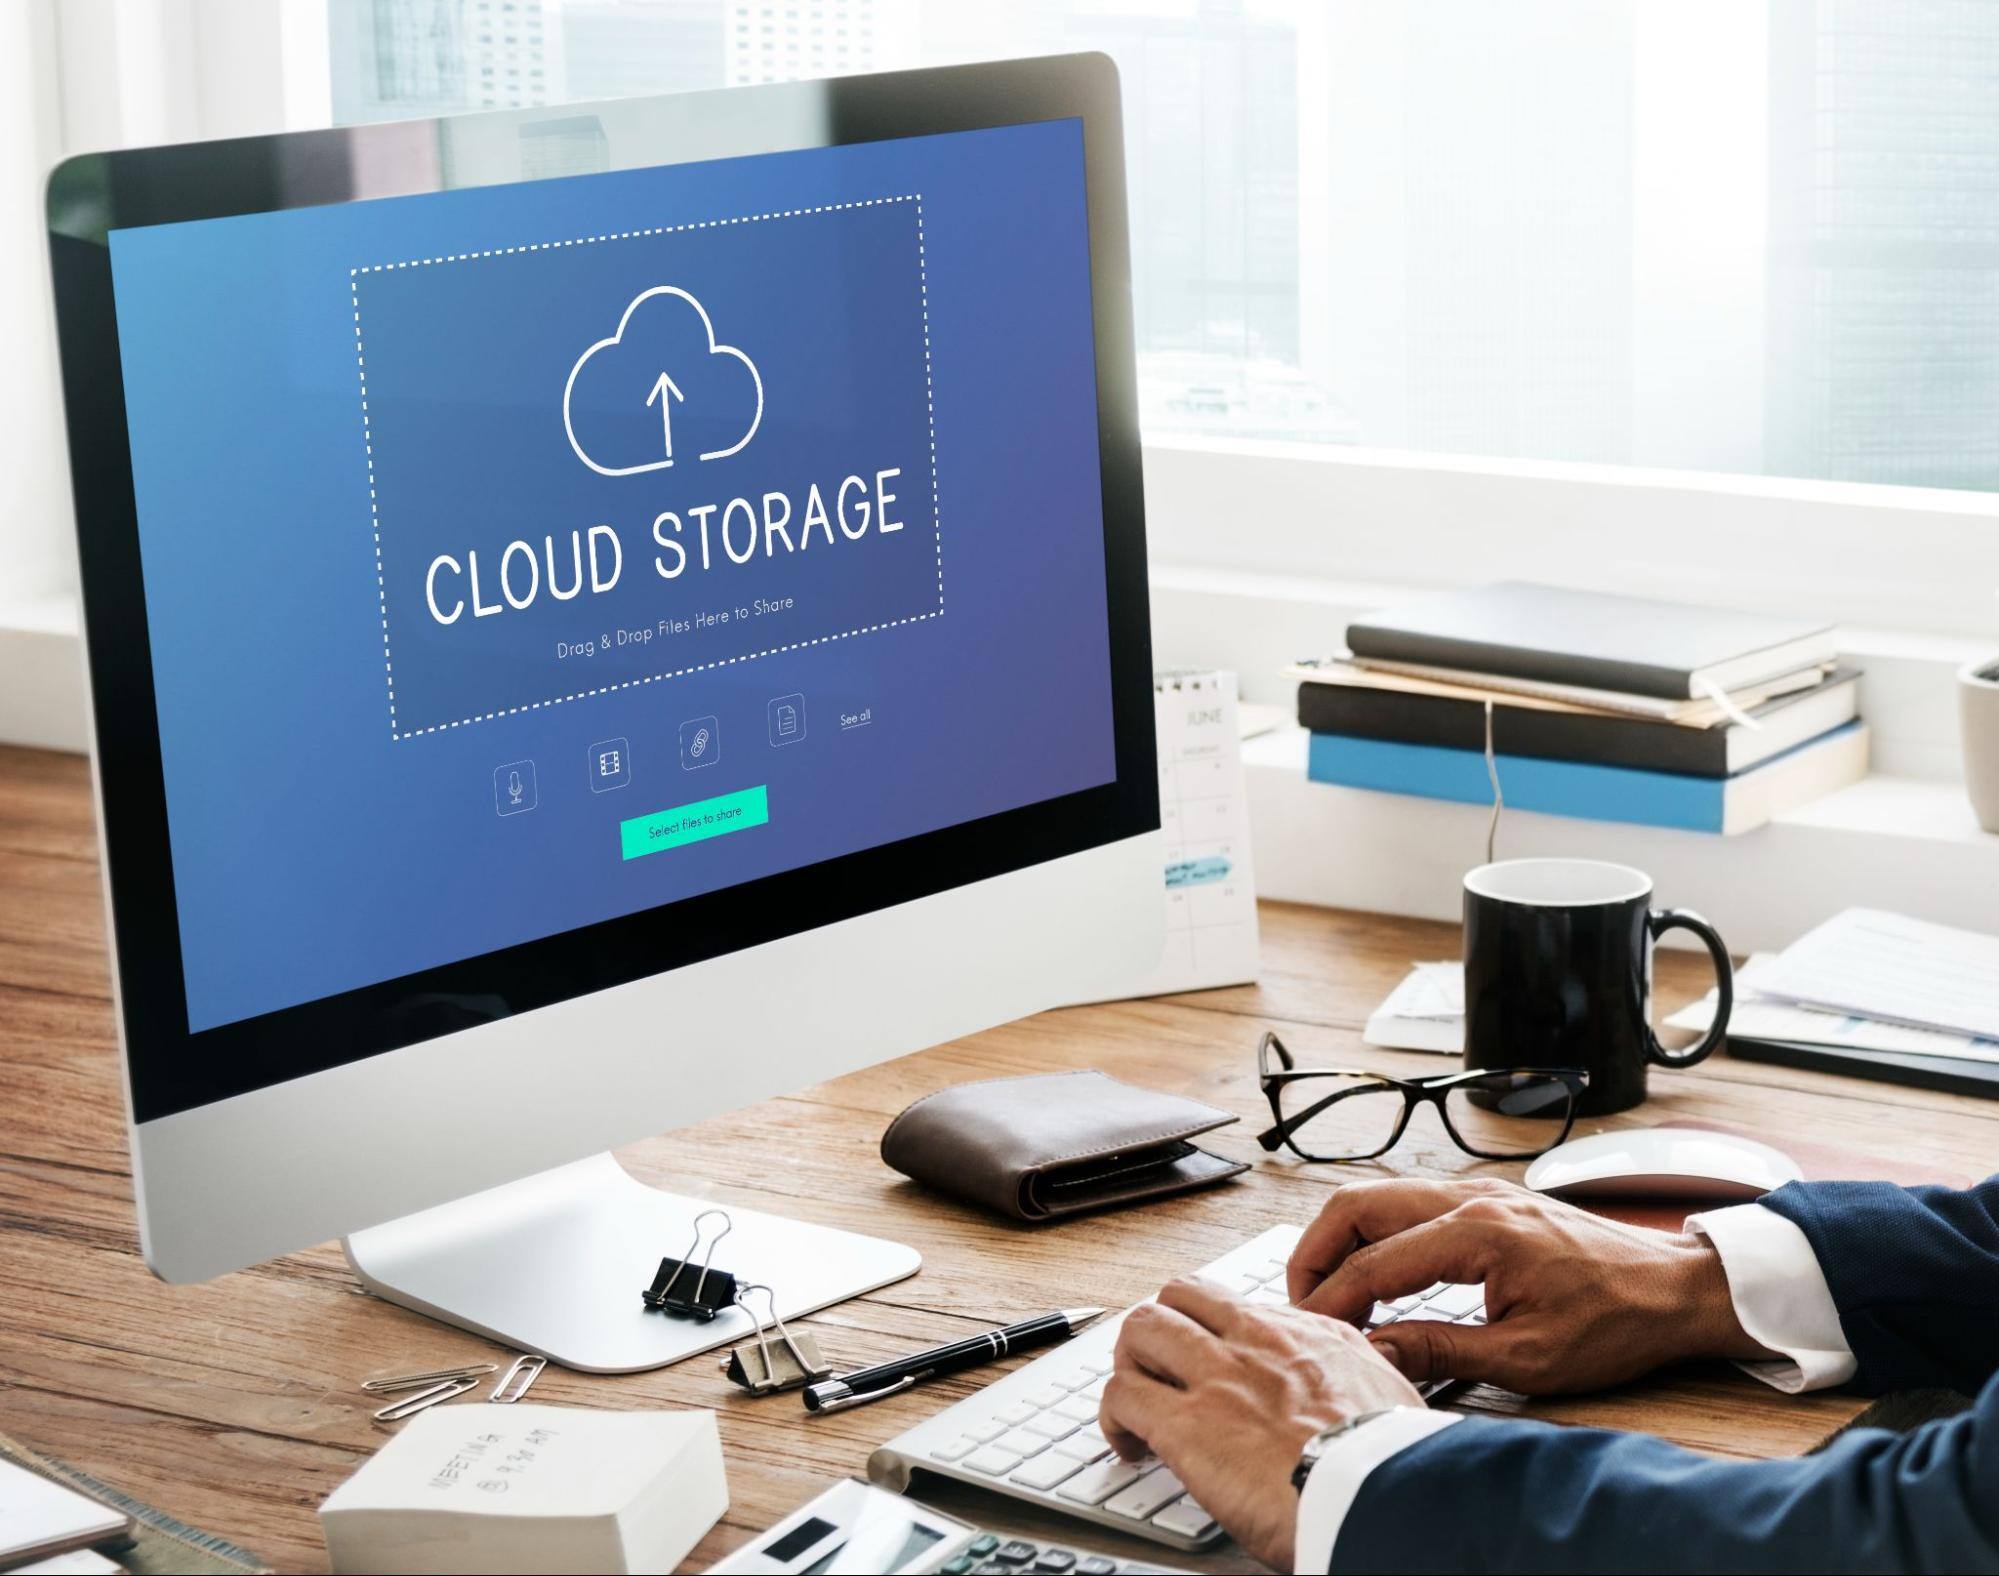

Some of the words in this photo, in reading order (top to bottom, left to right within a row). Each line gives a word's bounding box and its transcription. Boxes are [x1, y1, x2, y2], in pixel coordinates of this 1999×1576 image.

[426, 525, 623, 625] CLOUD
[652, 467, 904, 579] STORAGE
[557, 642, 595, 659] Drag
[601, 634, 611, 649] &
[617, 629, 652, 646] Drop
[658, 619, 690, 637] Files
[695, 611, 729, 629] Here
[734, 606, 749, 620] to
[753, 598, 794, 616] Share
[840, 713, 858, 726] See
[860, 708, 871, 721] all
[1186, 707, 1223, 728] JUNE
[648, 823, 680, 839] Select
[682, 817, 702, 831] files
[704, 814, 714, 824] to
[716, 807, 742, 822] share
